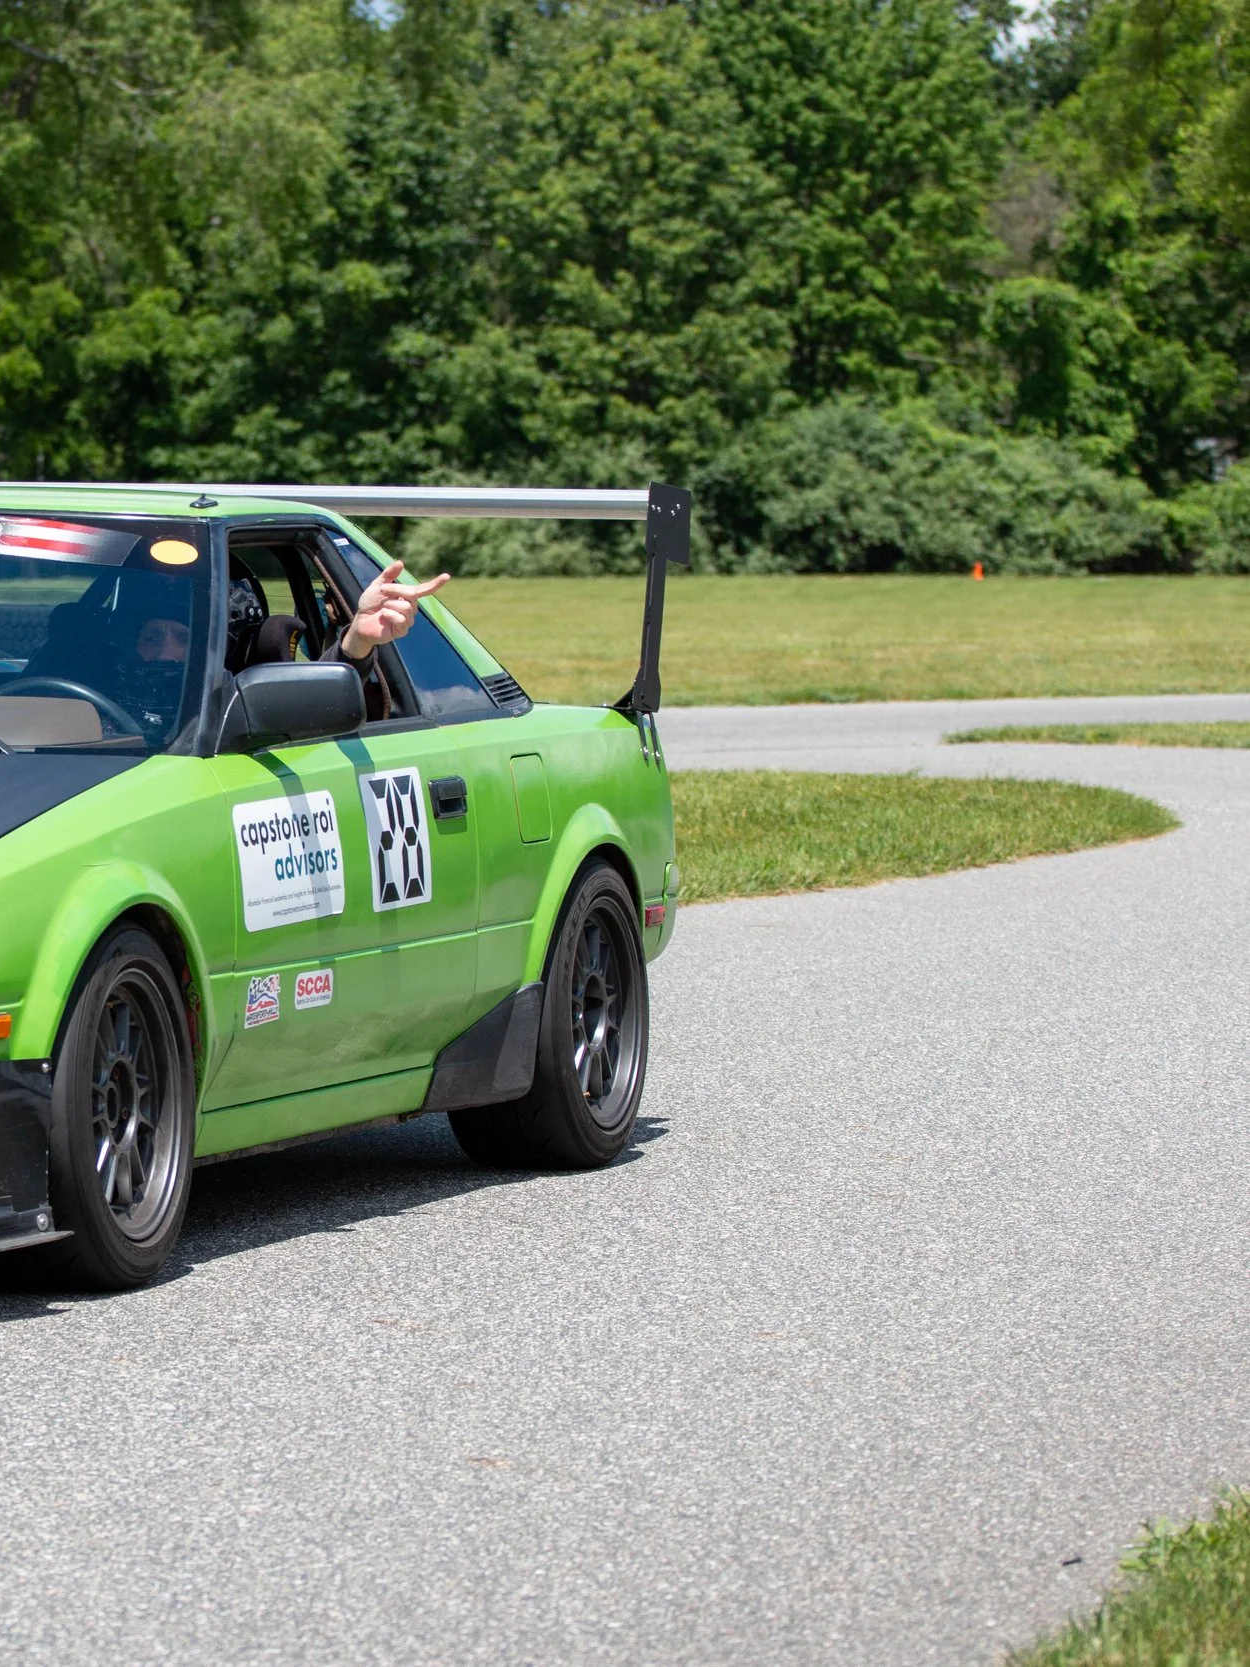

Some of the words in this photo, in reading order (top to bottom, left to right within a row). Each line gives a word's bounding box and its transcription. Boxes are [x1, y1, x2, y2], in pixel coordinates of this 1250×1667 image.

[240, 812, 310, 855] capstone
[312, 797, 334, 835] roi
[368, 775, 425, 904] 28
[275, 843, 337, 881] advisors
[297, 974, 331, 997] SCCA
